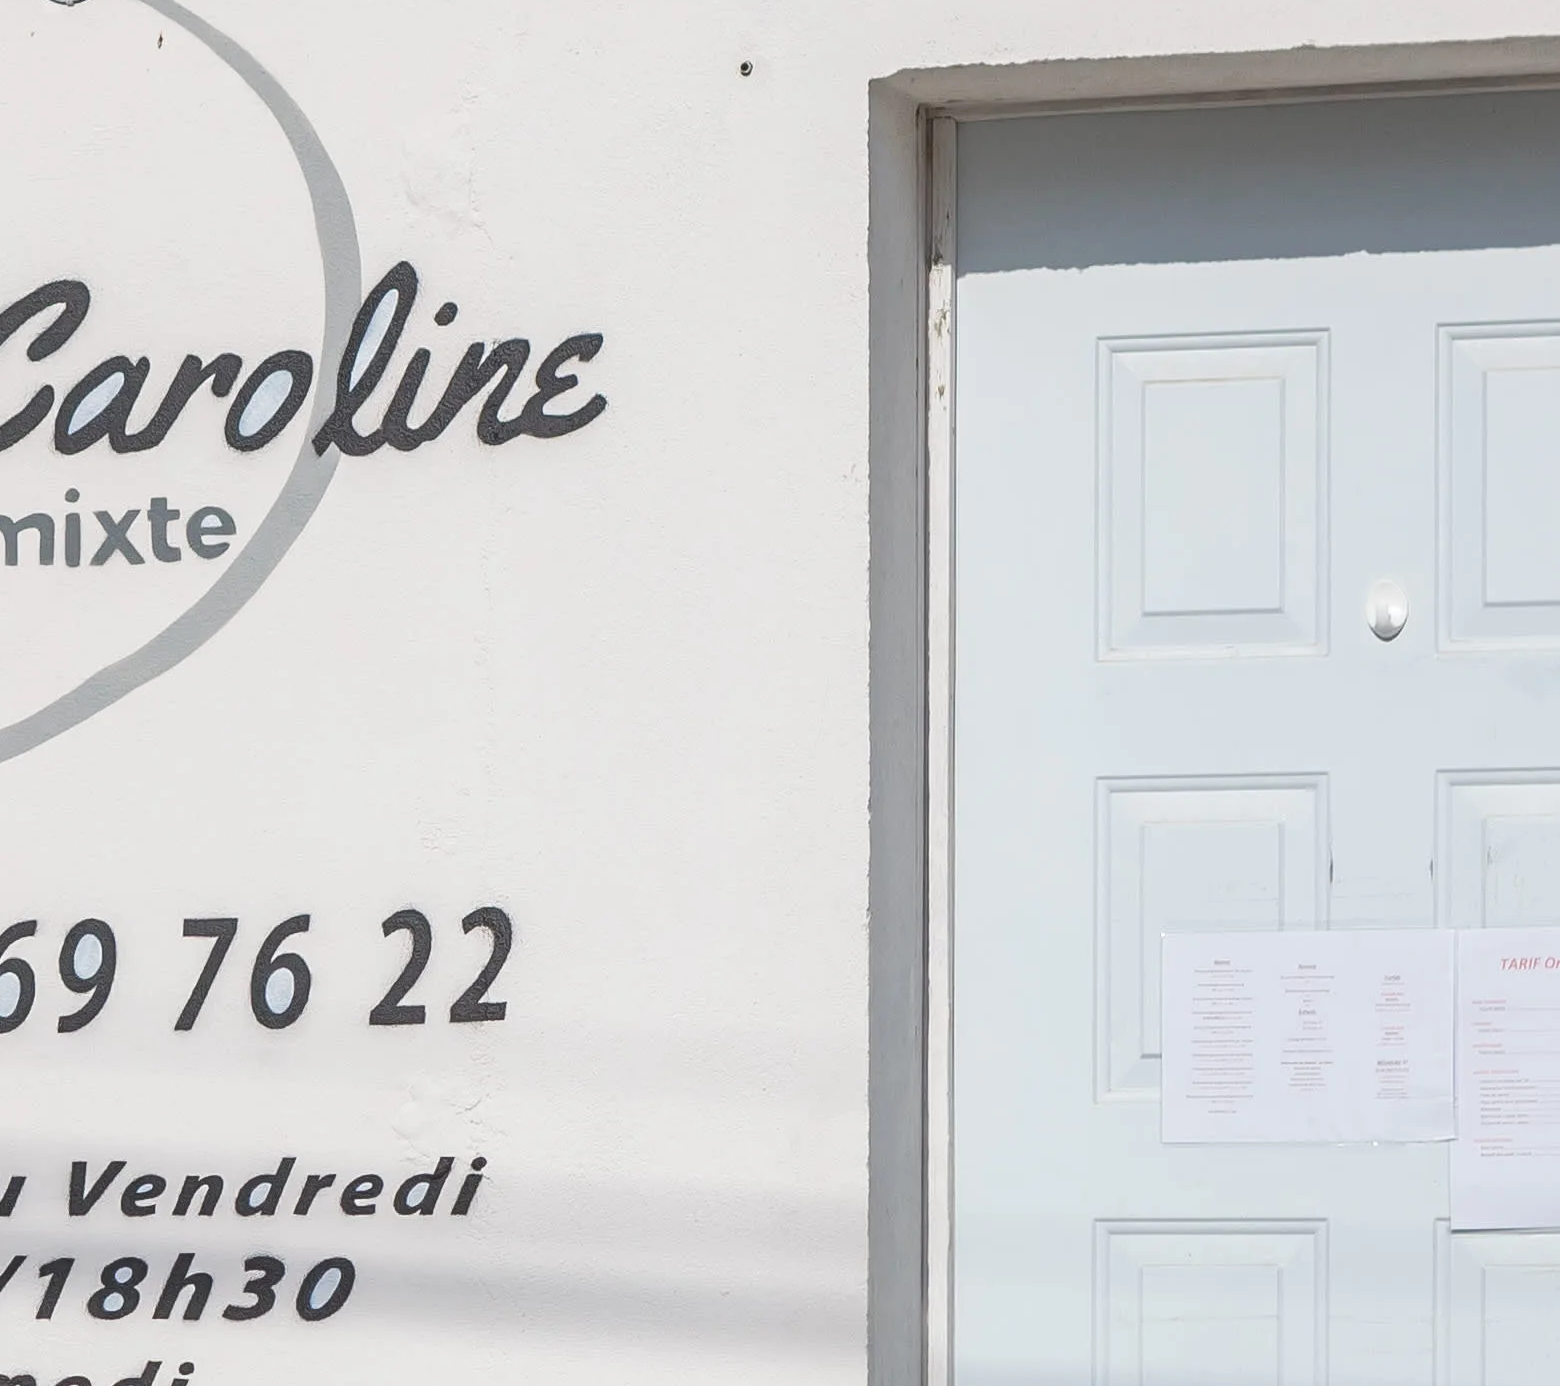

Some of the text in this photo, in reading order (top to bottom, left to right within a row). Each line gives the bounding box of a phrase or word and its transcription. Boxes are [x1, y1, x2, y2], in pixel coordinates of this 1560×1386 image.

[173, 913, 313, 1033] 76
[367, 905, 514, 1027] 22
[1500, 957, 1541, 970] TARIF
[67, 1155, 487, 1219] Vendredi
